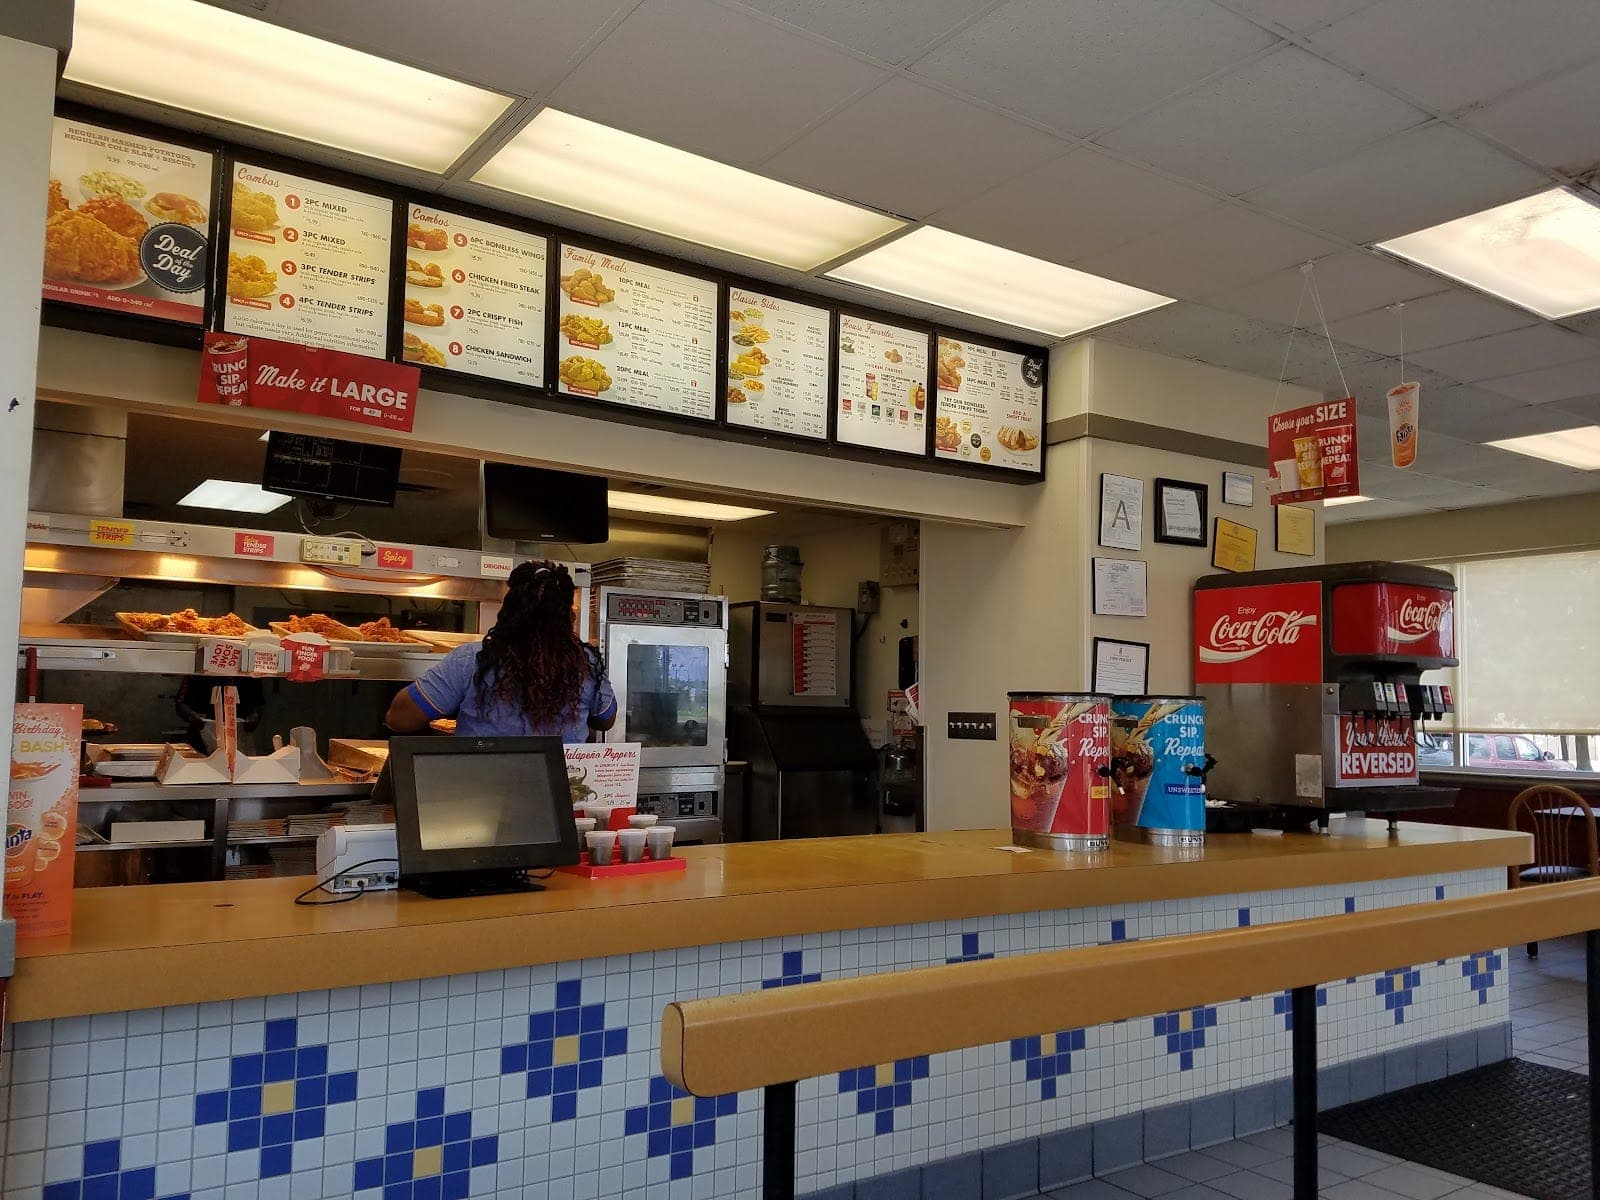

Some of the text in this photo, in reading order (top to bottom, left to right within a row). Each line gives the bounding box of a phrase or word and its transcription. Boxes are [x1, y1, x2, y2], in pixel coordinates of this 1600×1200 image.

[68, 127, 110, 142] REGULAR
[111, 137, 148, 151] MASHED
[63, 133, 106, 148] REGULAR
[107, 142, 130, 153] COLE
[131, 148, 154, 159] SLAW
[161, 156, 197, 169] BISCUIT
[237, 167, 281, 189] Combos
[304, 196, 321, 208] 2PC
[321, 201, 348, 215] MIXED
[412, 207, 450, 228] Combos
[153, 233, 203, 262] Deal
[302, 230, 319, 242] 3PC
[320, 234, 347, 247] MIXED
[470, 236, 484, 246] 6PC
[485, 239, 520, 256] BONELESS
[521, 248, 546, 261] WINGS
[152, 252, 193, 283] Day
[564, 247, 628, 275] Family Meals
[300, 263, 318, 275] 3PC
[318, 266, 350, 280] TENDER
[350, 273, 377, 286] STRIPS
[468, 272, 500, 286] CHICKEN
[500, 279, 520, 291] FRIED
[519, 284, 541, 296] STEAK
[41, 283, 69, 293] EGULAR
[634, 280, 651, 290] MEAL
[298, 296, 316, 308] 4PC
[316, 300, 347, 314] TENDER
[348, 306, 376, 319] STRIPS
[731, 290, 781, 313] Classic Sides
[466, 307, 482, 318] 2PC
[482, 311, 508, 324] CRISPY
[508, 316, 524, 328] FISH
[842, 319, 863, 332] House
[633, 323, 651, 334] MEAL
[465, 344, 496, 357] CHICKEN
[496, 349, 532, 364] SANDWICH
[212, 358, 248, 374] RUNC
[632, 369, 650, 379] MEAL
[216, 379, 248, 397] EPEA
[220, 373, 241, 385] SIP.
[255, 364, 409, 410] Make it LARGE
[1272, 401, 1348, 434] Choose your SIZE
[1111, 499, 1131, 531] A
[95, 525, 129, 535] TENDER
[95, 532, 125, 542] STRIPS
[243, 541, 267, 549] TENDER
[383, 549, 408, 566] Spicy
[1237, 606, 1257, 616] Enjoy
[1210, 610, 1303, 648] Coca-Cola
[209, 643, 223, 666] LOVE
[221, 643, 234, 669] SOME
[228, 648, 241, 667] BAG
[296, 650, 318, 658] FINGER
[13, 721, 63, 737] Birthday
[1179, 726, 1199, 738] SIP.
[20, 740, 66, 754] BASH
[602, 747, 637, 762] Peppers
[1341, 751, 1414, 775] REVERSED
[6, 828, 33, 850] nta
